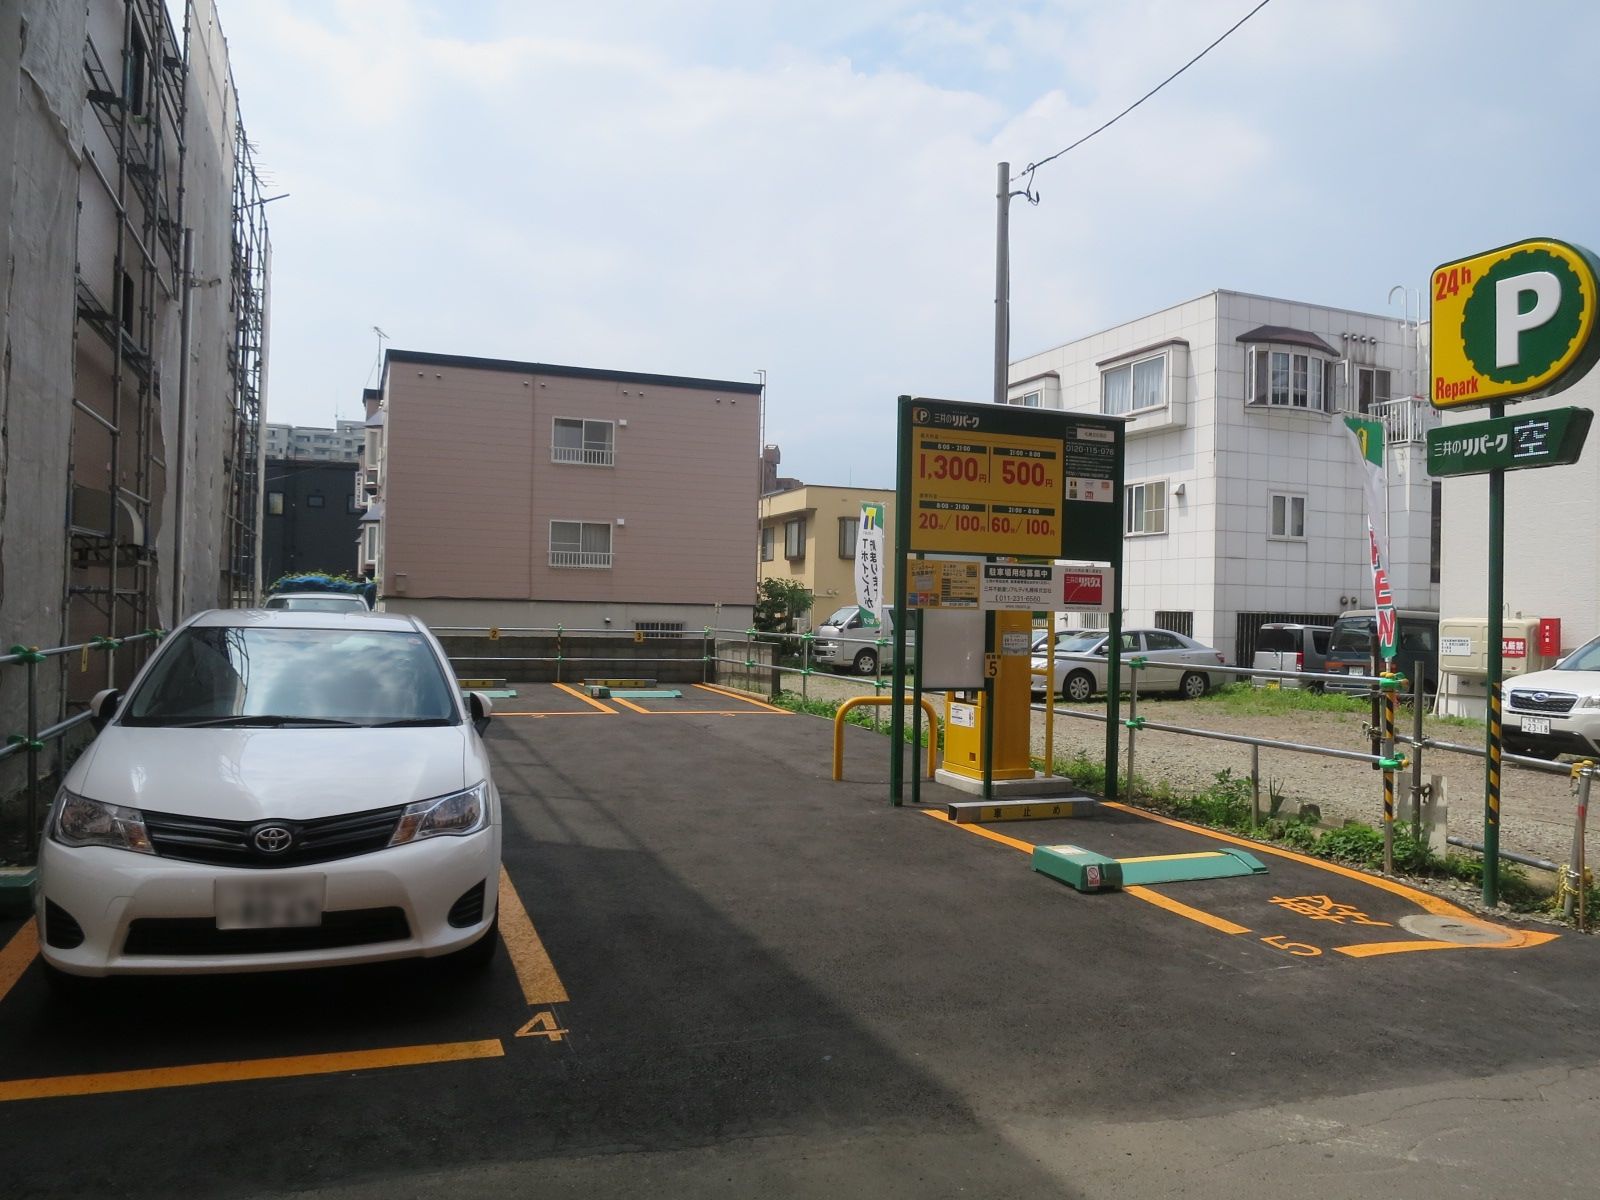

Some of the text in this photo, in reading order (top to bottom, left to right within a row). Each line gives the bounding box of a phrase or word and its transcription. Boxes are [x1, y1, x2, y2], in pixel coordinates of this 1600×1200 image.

[1495, 271, 1562, 369] P
[1435, 376, 1479, 401] Repark
[934, 412, 980, 428] 三井のリパーク
[1433, 432, 1508, 459] 三井のリパーク
[1513, 420, 1550, 457] 空
[1002, 460, 1053, 488] 500円
[988, 566, 1048, 579] 駐車場用地募集中
[491, 630, 498, 638] 2
[636, 632, 643, 640] 3
[988, 661, 998, 677] 5
[993, 805, 1061, 818] 車止め
[1260, 935, 1323, 957] 5
[514, 1011, 570, 1042] 4
